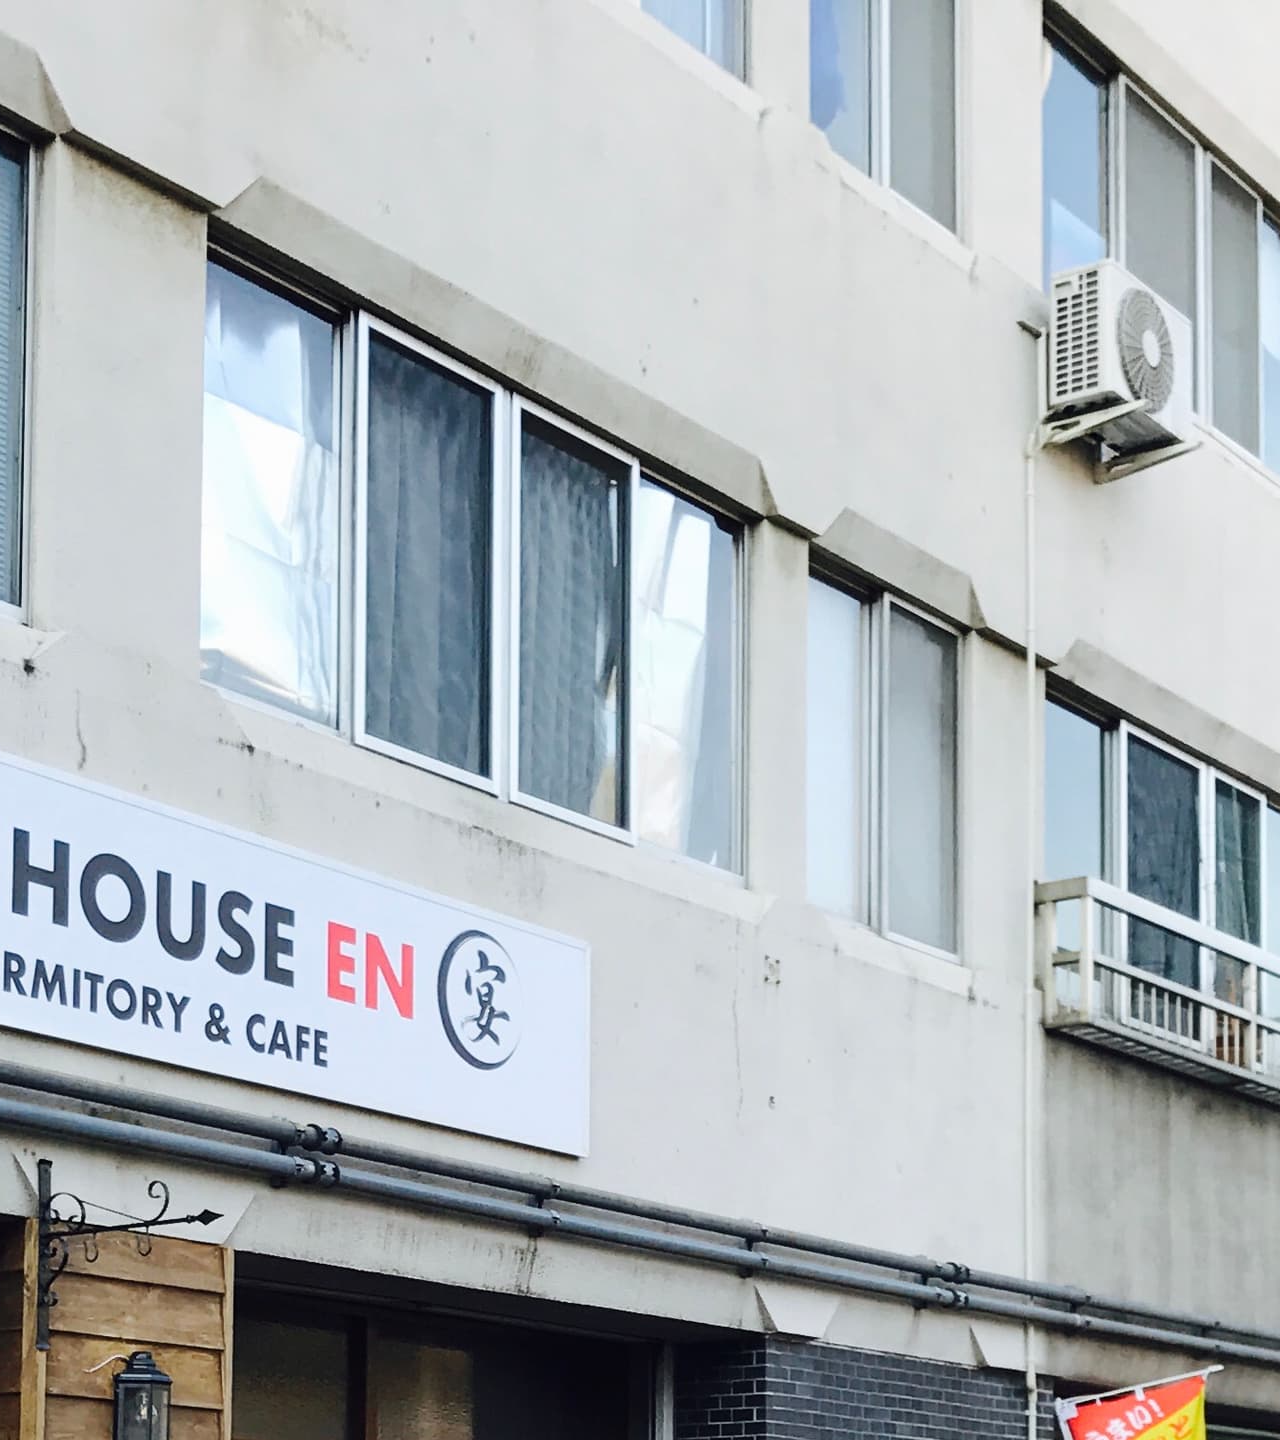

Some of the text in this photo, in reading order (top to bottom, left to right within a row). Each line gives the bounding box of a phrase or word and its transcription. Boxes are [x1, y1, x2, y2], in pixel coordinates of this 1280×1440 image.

[11, 828, 296, 988] HOUSE
[327, 921, 416, 1020] EN
[205, 1002, 232, 1043] &
[247, 1014, 330, 1069] CAFE
